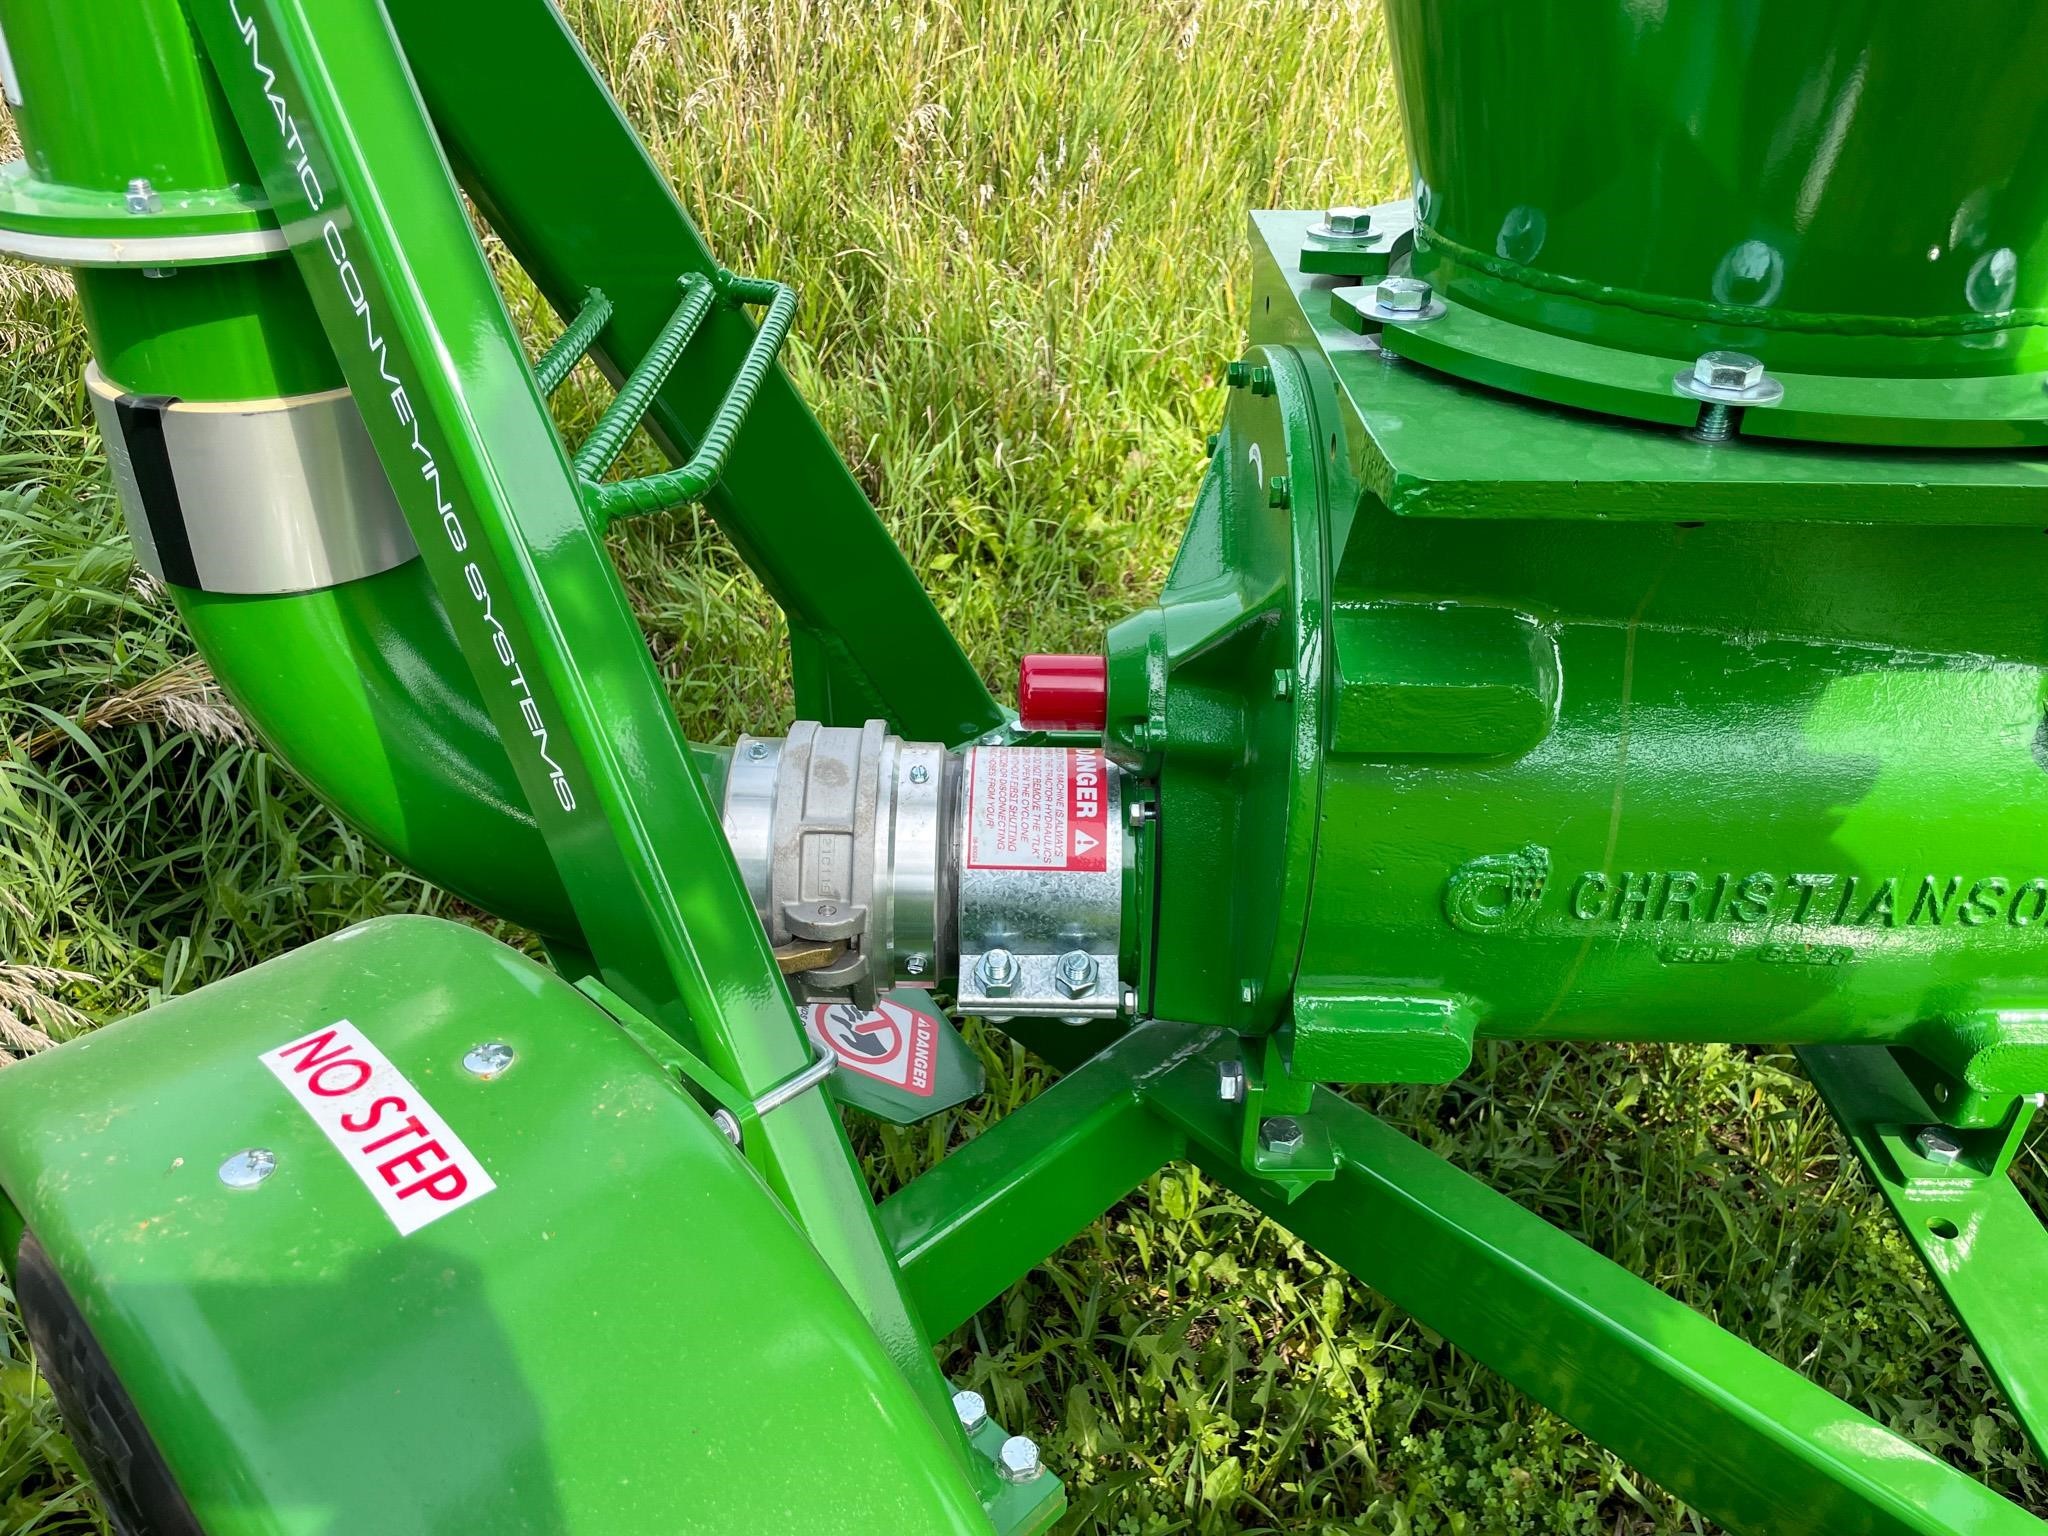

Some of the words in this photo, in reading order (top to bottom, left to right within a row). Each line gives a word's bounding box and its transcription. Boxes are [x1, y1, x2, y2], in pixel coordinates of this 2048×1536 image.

[322, 218, 468, 553] CONVEYING
[465, 562, 577, 813] SYSTEMS
[1010, 782, 1018, 804] FIRST
[1033, 779, 1041, 811] REMOVE
[1045, 770, 1053, 804] TRACTOR
[1056, 774, 1064, 807] MACHINE
[1075, 749, 1098, 818] DANGER
[998, 780, 1007, 850] DISCONNECTING
[1008, 806, 1017, 852] SHUTTING
[1021, 799, 1029, 842] CYCLONE
[1044, 805, 1052, 864] HYDRAULICS
[1055, 819, 1063, 857] ALWAYS
[912, 1032, 931, 1089] DANGER
[278, 1030, 373, 1097] NO
[340, 1096, 469, 1201] STEP
